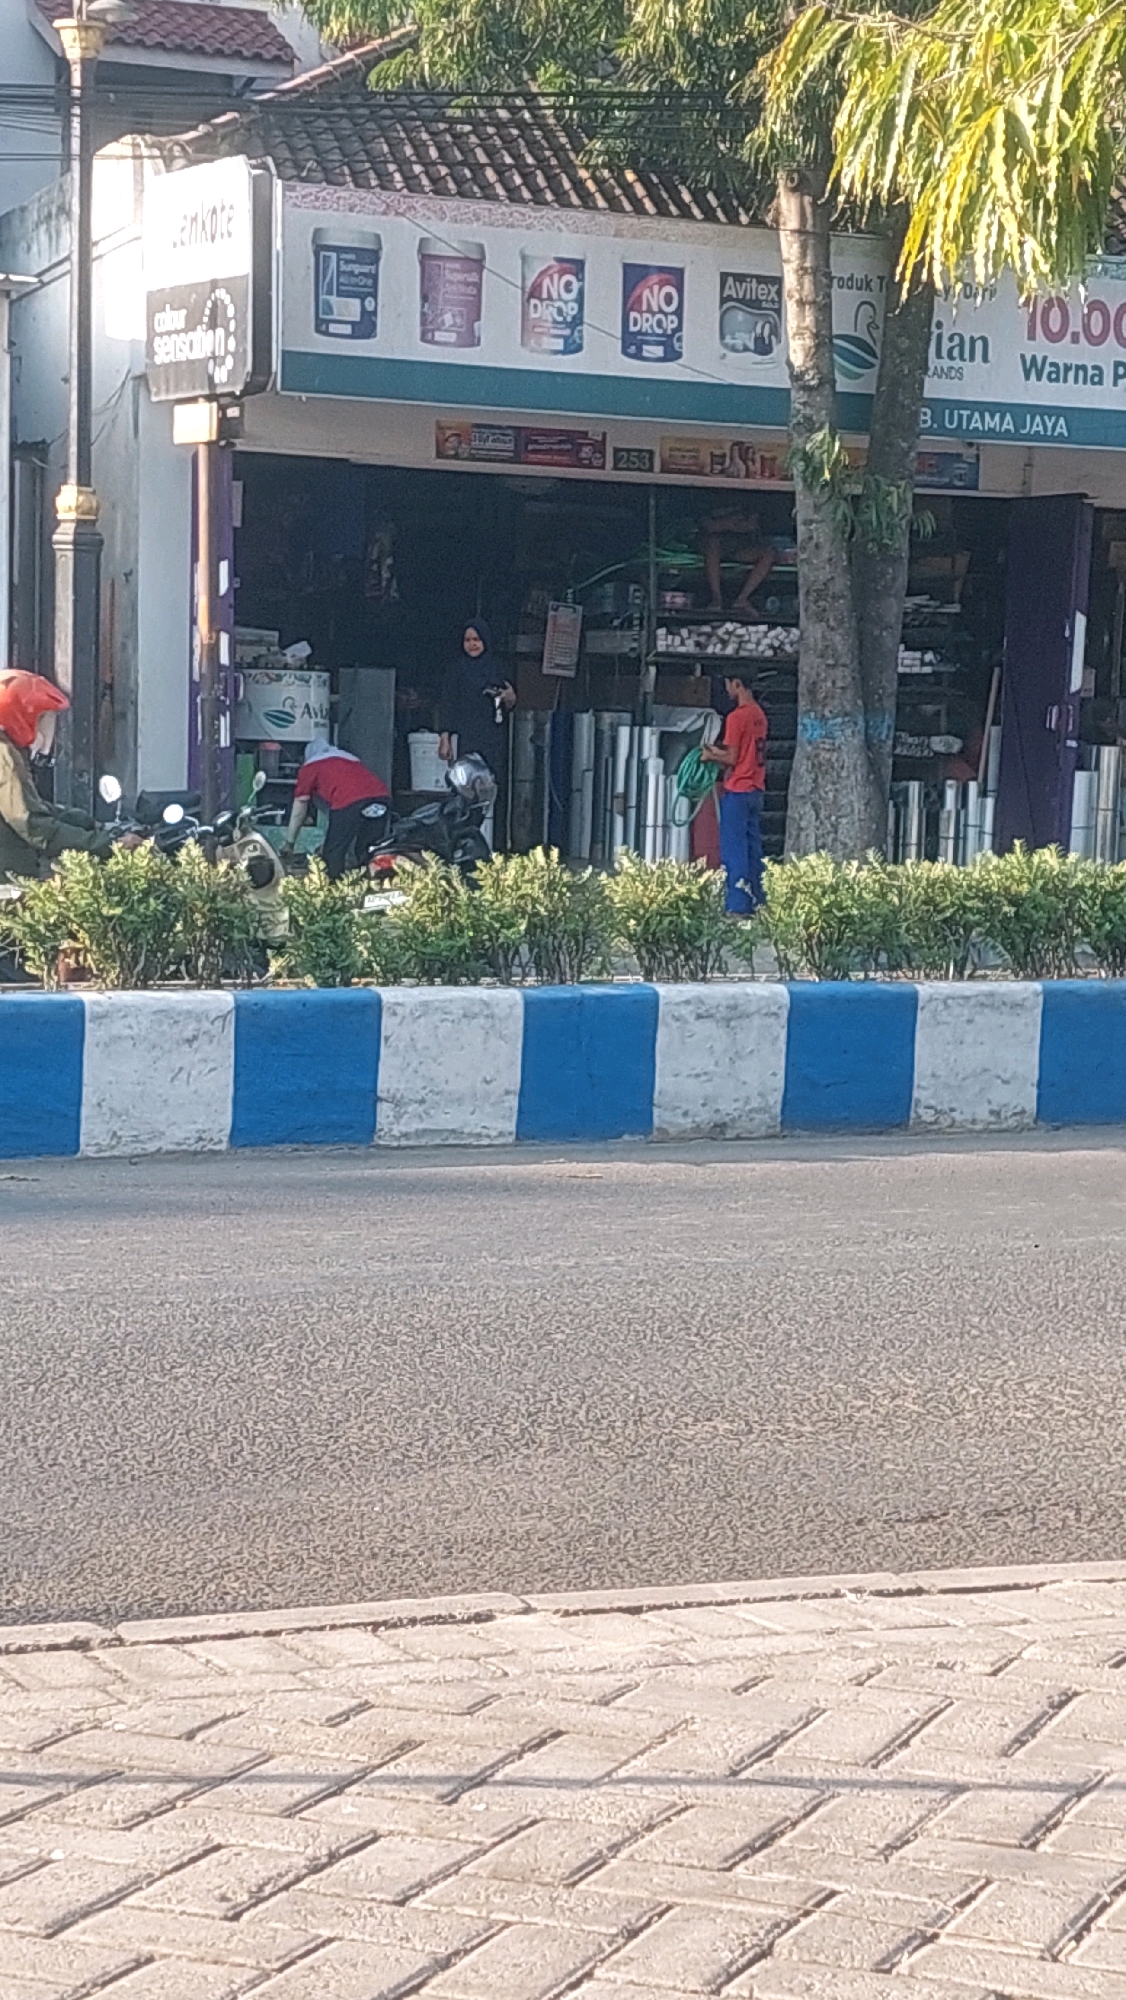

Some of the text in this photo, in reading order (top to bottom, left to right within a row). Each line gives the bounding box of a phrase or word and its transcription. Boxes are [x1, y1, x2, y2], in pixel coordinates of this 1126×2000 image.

[541, 273, 579, 300] NO
[722, 276, 780, 302] Avitex
[830, 272, 873, 292] roduk
[530, 298, 579, 323] DROP
[642, 285, 679, 313] NO
[629, 312, 679, 335] DROP
[930, 320, 991, 365] ian
[926, 364, 964, 382] ANDS
[1020, 353, 1104, 387] Warna
[944, 409, 1015, 434] UTAMA
[1020, 413, 1069, 438] JAYA
